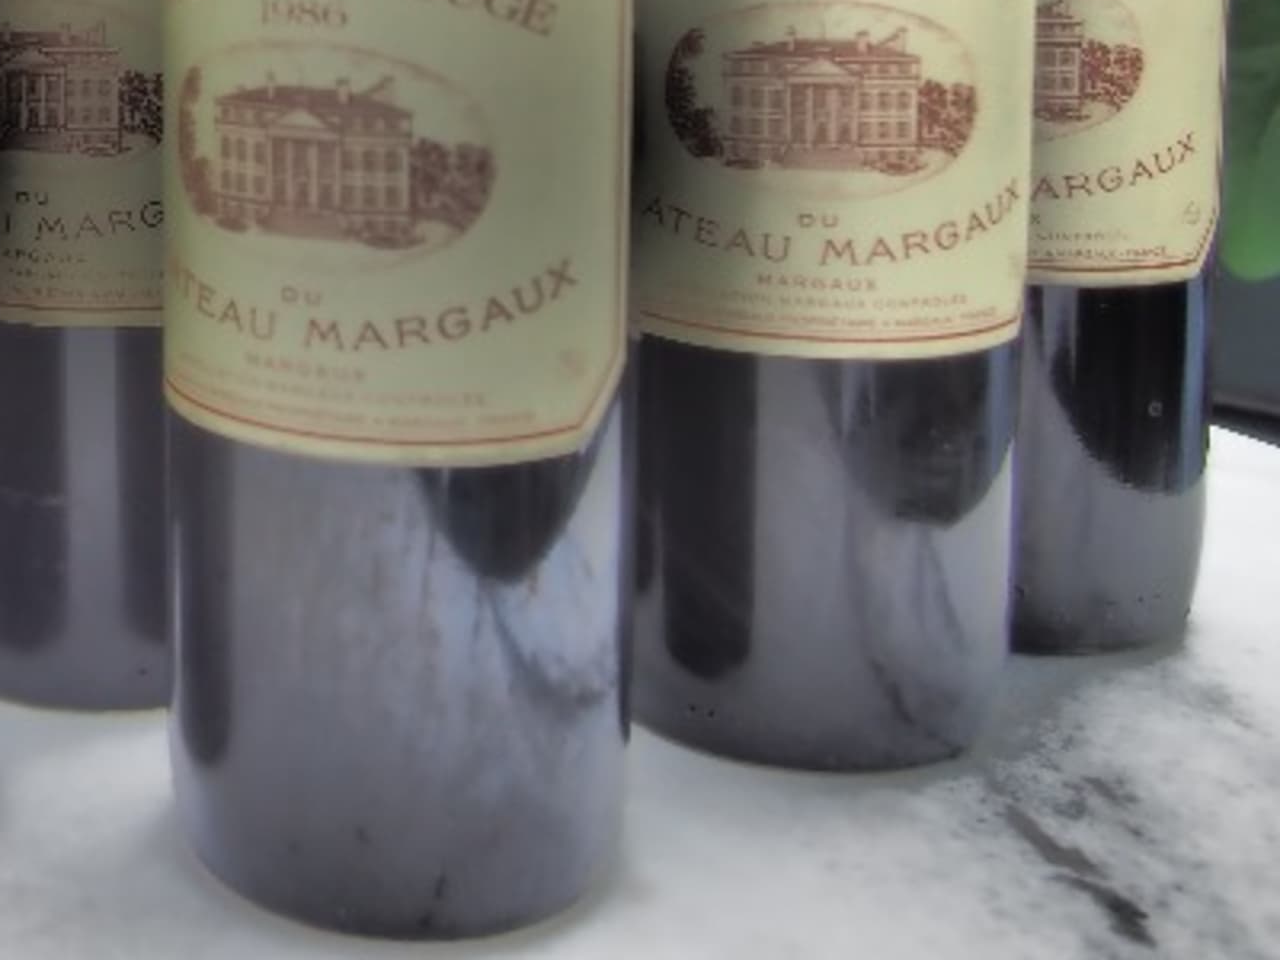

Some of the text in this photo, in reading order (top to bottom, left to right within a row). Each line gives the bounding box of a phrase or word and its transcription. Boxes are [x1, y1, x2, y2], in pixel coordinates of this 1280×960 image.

[1030, 130, 1196, 202] ARGAUX
[35, 200, 165, 242] MARG
[641, 178, 1021, 267] ATEAU MARGAUX
[796, 213, 840, 229] DU
[280, 286, 325, 306] DU
[303, 257, 579, 352] MARGAUX
